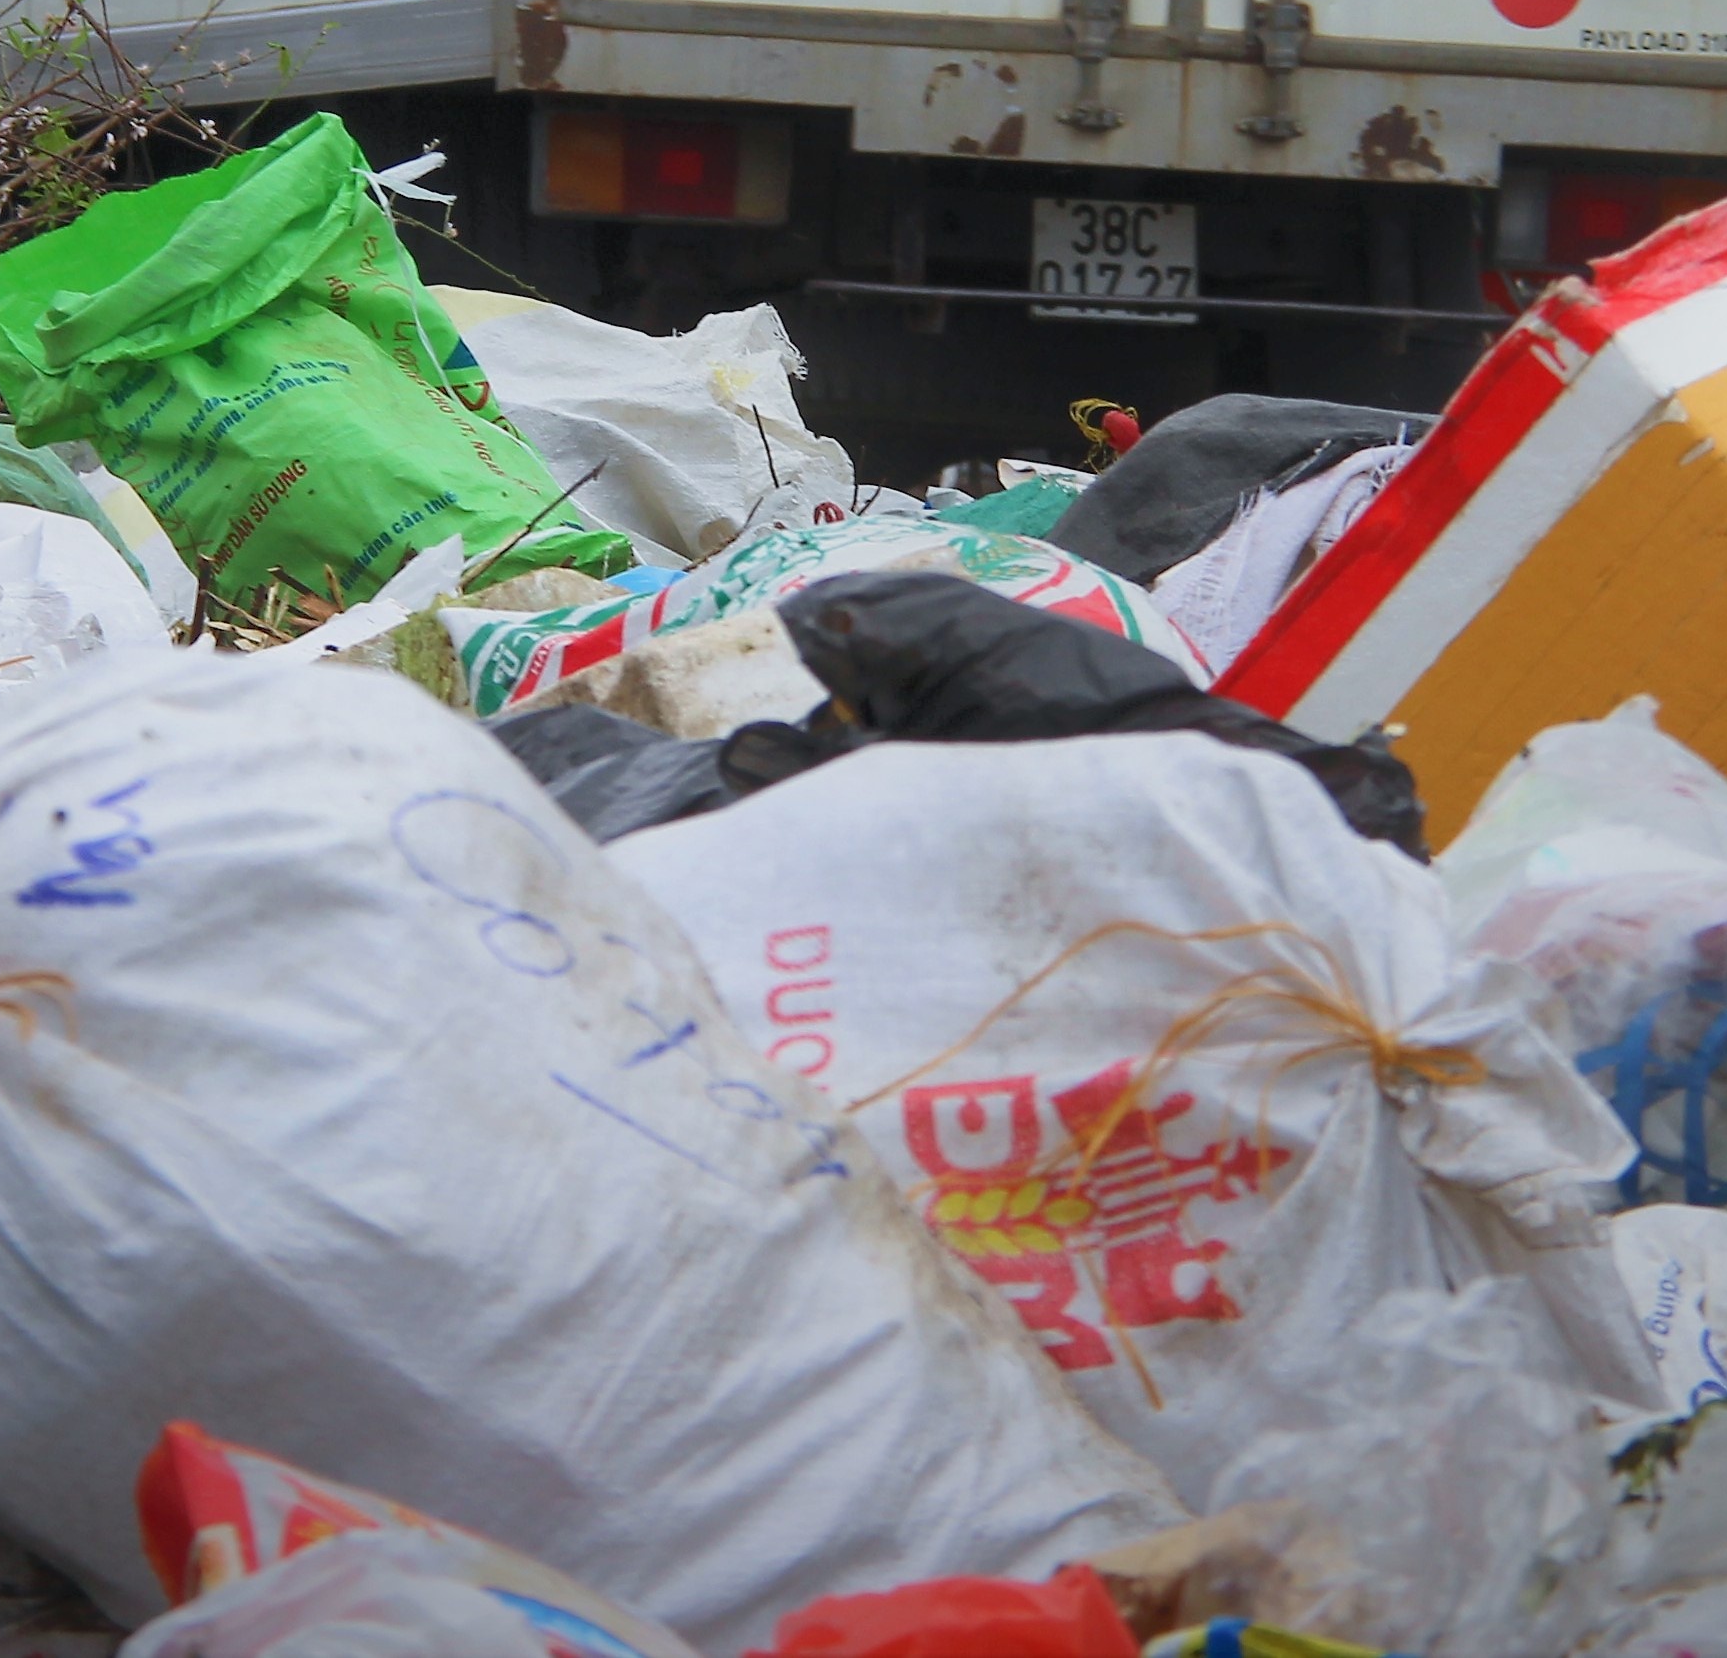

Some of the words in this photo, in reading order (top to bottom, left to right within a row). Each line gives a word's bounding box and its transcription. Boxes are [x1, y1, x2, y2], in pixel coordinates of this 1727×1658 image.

[1579, 28, 1692, 53] PAYLOAD
[1071, 203, 1159, 259] 38C
[1037, 259, 1194, 313] 01727
[269, 458, 309, 507] DỤNG
